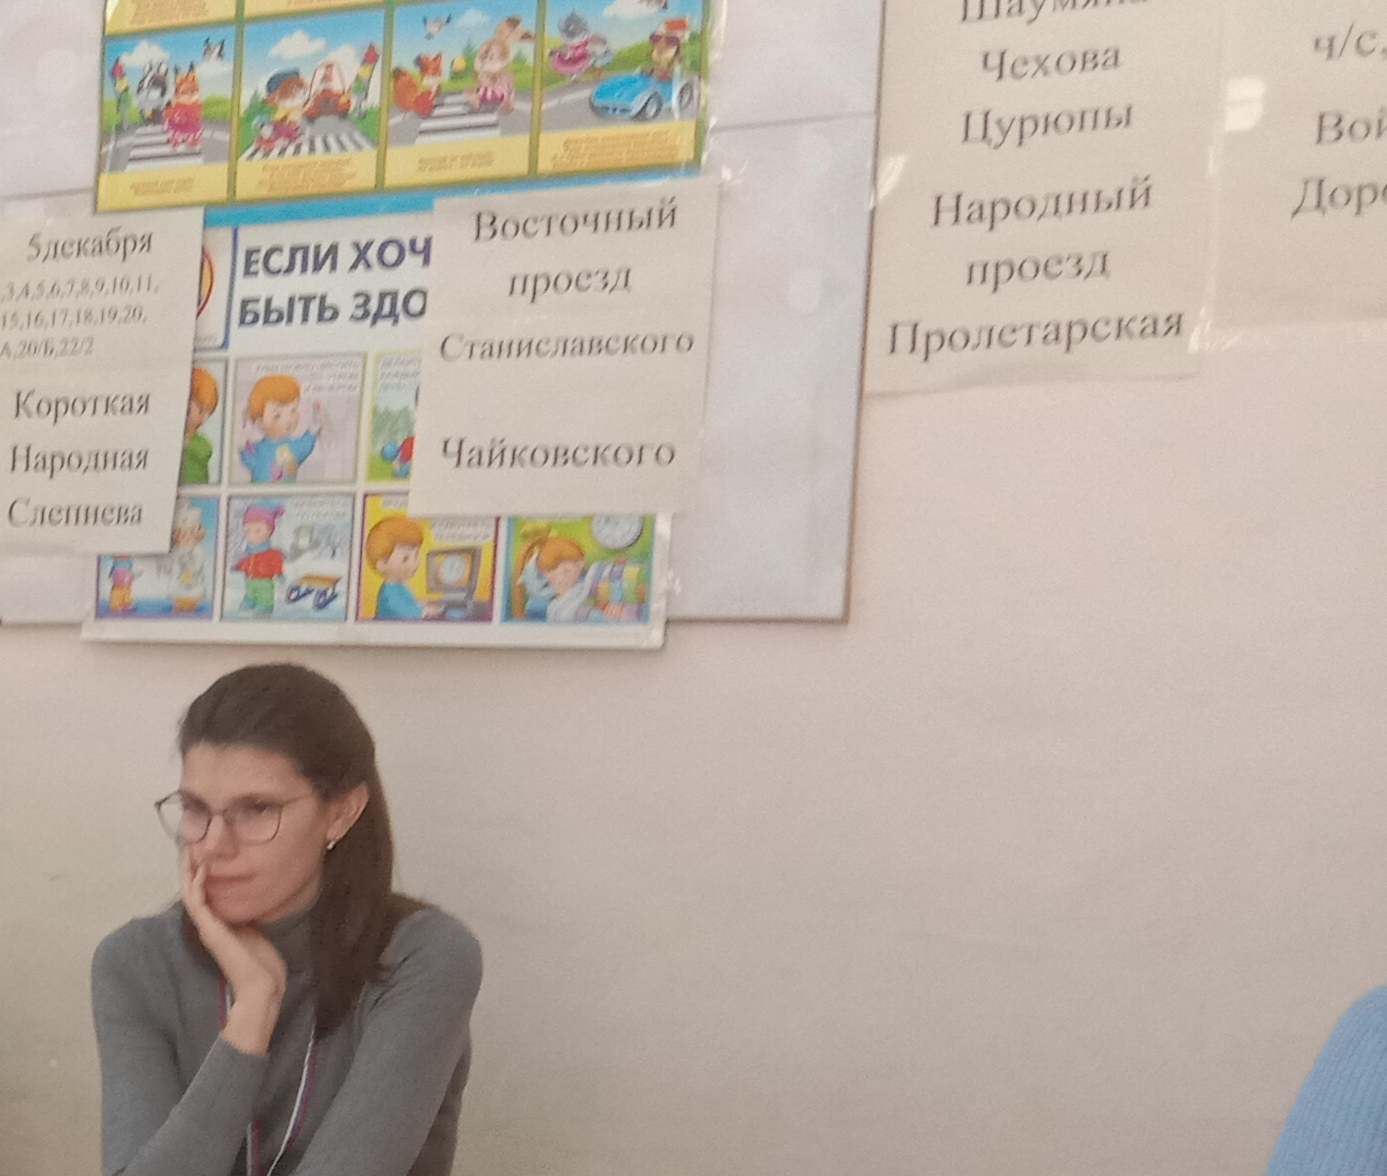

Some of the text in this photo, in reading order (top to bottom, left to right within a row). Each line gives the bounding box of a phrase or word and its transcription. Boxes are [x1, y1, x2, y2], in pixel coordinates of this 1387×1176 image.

[982, 45, 1122, 82] Чехова
[960, 103, 1134, 149] Цурюпы
[472, 197, 679, 243] Восточный
[931, 174, 1153, 232] Народный
[27, 226, 153, 264] 5декабря
[243, 235, 433, 278] ЕСЛИ ХОЧ
[508, 266, 632, 303] проезд
[965, 249, 1111, 293] проезд
[238, 287, 427, 328] БЫТЬ ЗДО
[439, 332, 695, 362] Станиславского
[887, 310, 1184, 362] Пролетарская
[14, 388, 151, 426] Короткая
[9, 444, 149, 480] Народная
[441, 437, 677, 470] Чайковского
[7, 497, 143, 528] Слепнева
